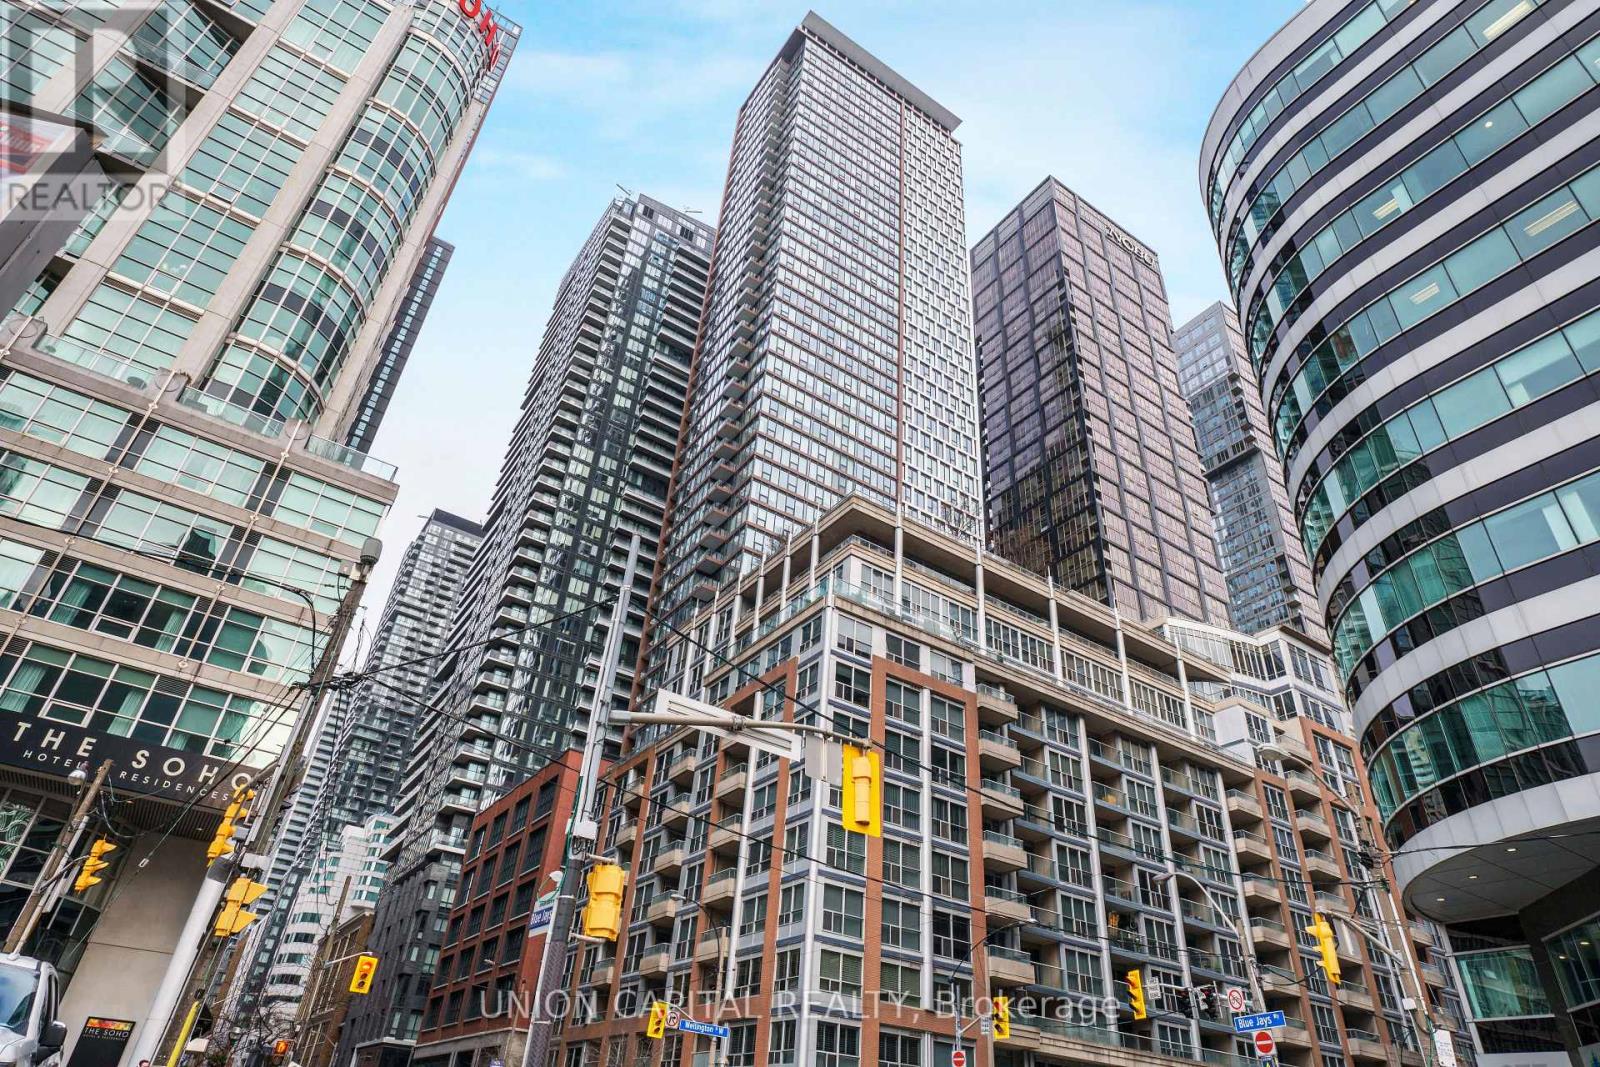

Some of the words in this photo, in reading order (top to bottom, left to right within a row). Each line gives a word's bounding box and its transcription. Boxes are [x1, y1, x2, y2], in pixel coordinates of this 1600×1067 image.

[1104, 225, 1155, 267] NOBU
[13, 721, 97, 758] THE
[132, 749, 252, 791] SOHO
[119, 770, 229, 801] RESIDENCES
[103, 1029, 129, 1037] SOHO
[685, 1021, 714, 1034] Wellington
[1238, 1018, 1254, 1029] Blue
[1256, 1016, 1273, 1028] Jays
